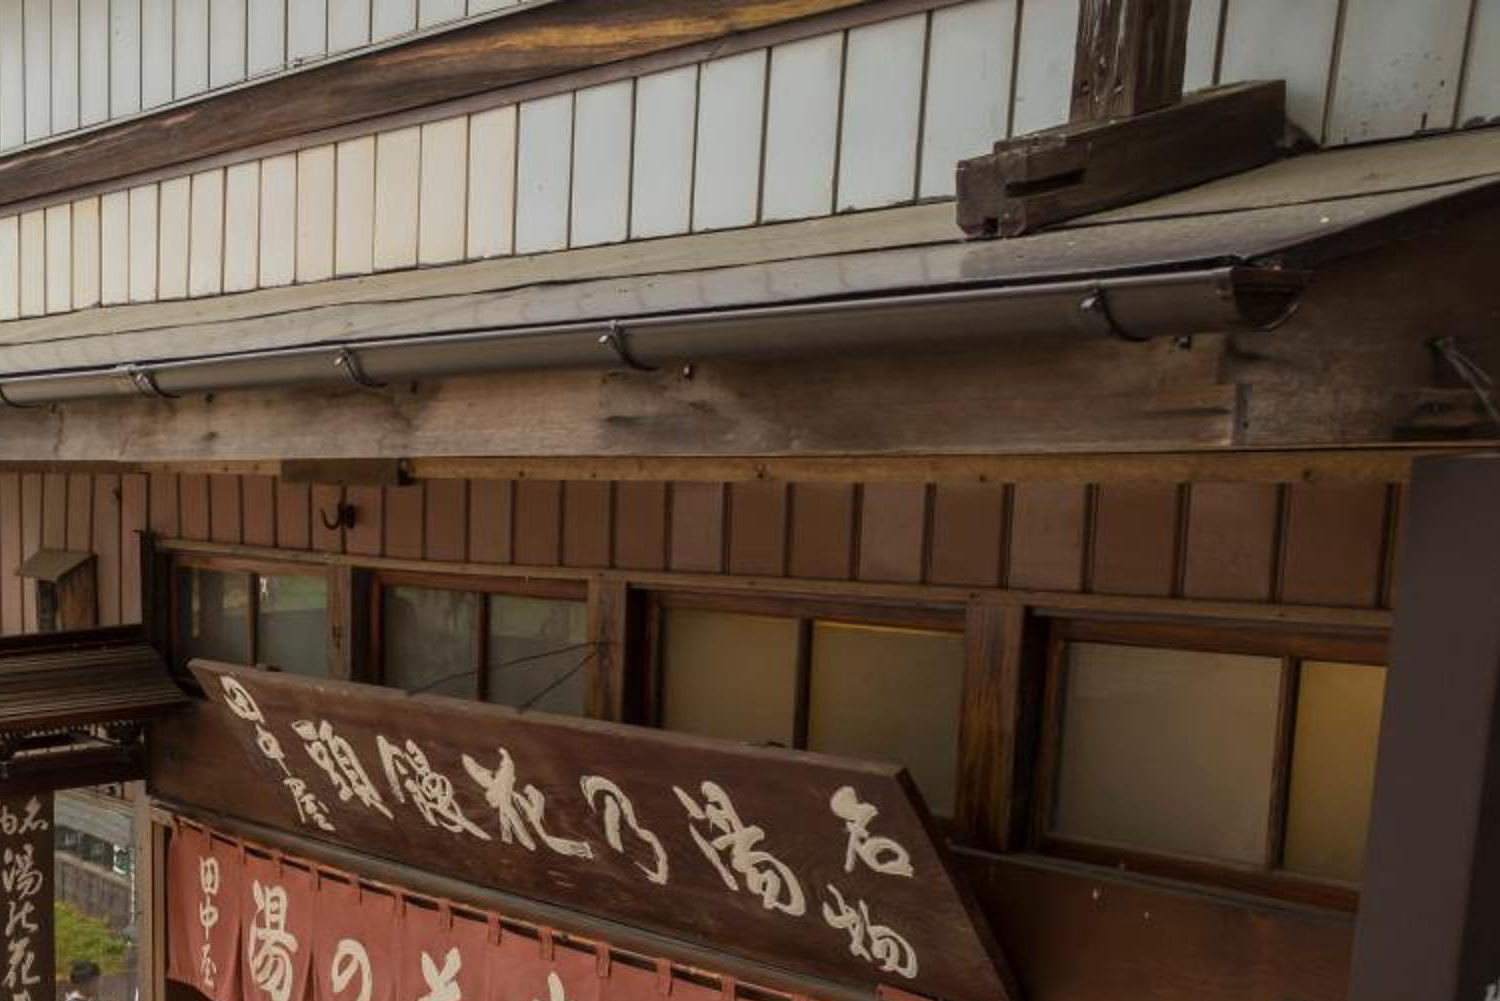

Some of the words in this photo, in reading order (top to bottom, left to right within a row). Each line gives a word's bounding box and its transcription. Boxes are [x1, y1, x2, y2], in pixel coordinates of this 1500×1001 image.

[222, 675, 335, 832] 田中屋
[198, 856, 220, 990] 田中屋
[822, 785, 918, 980] 名物
